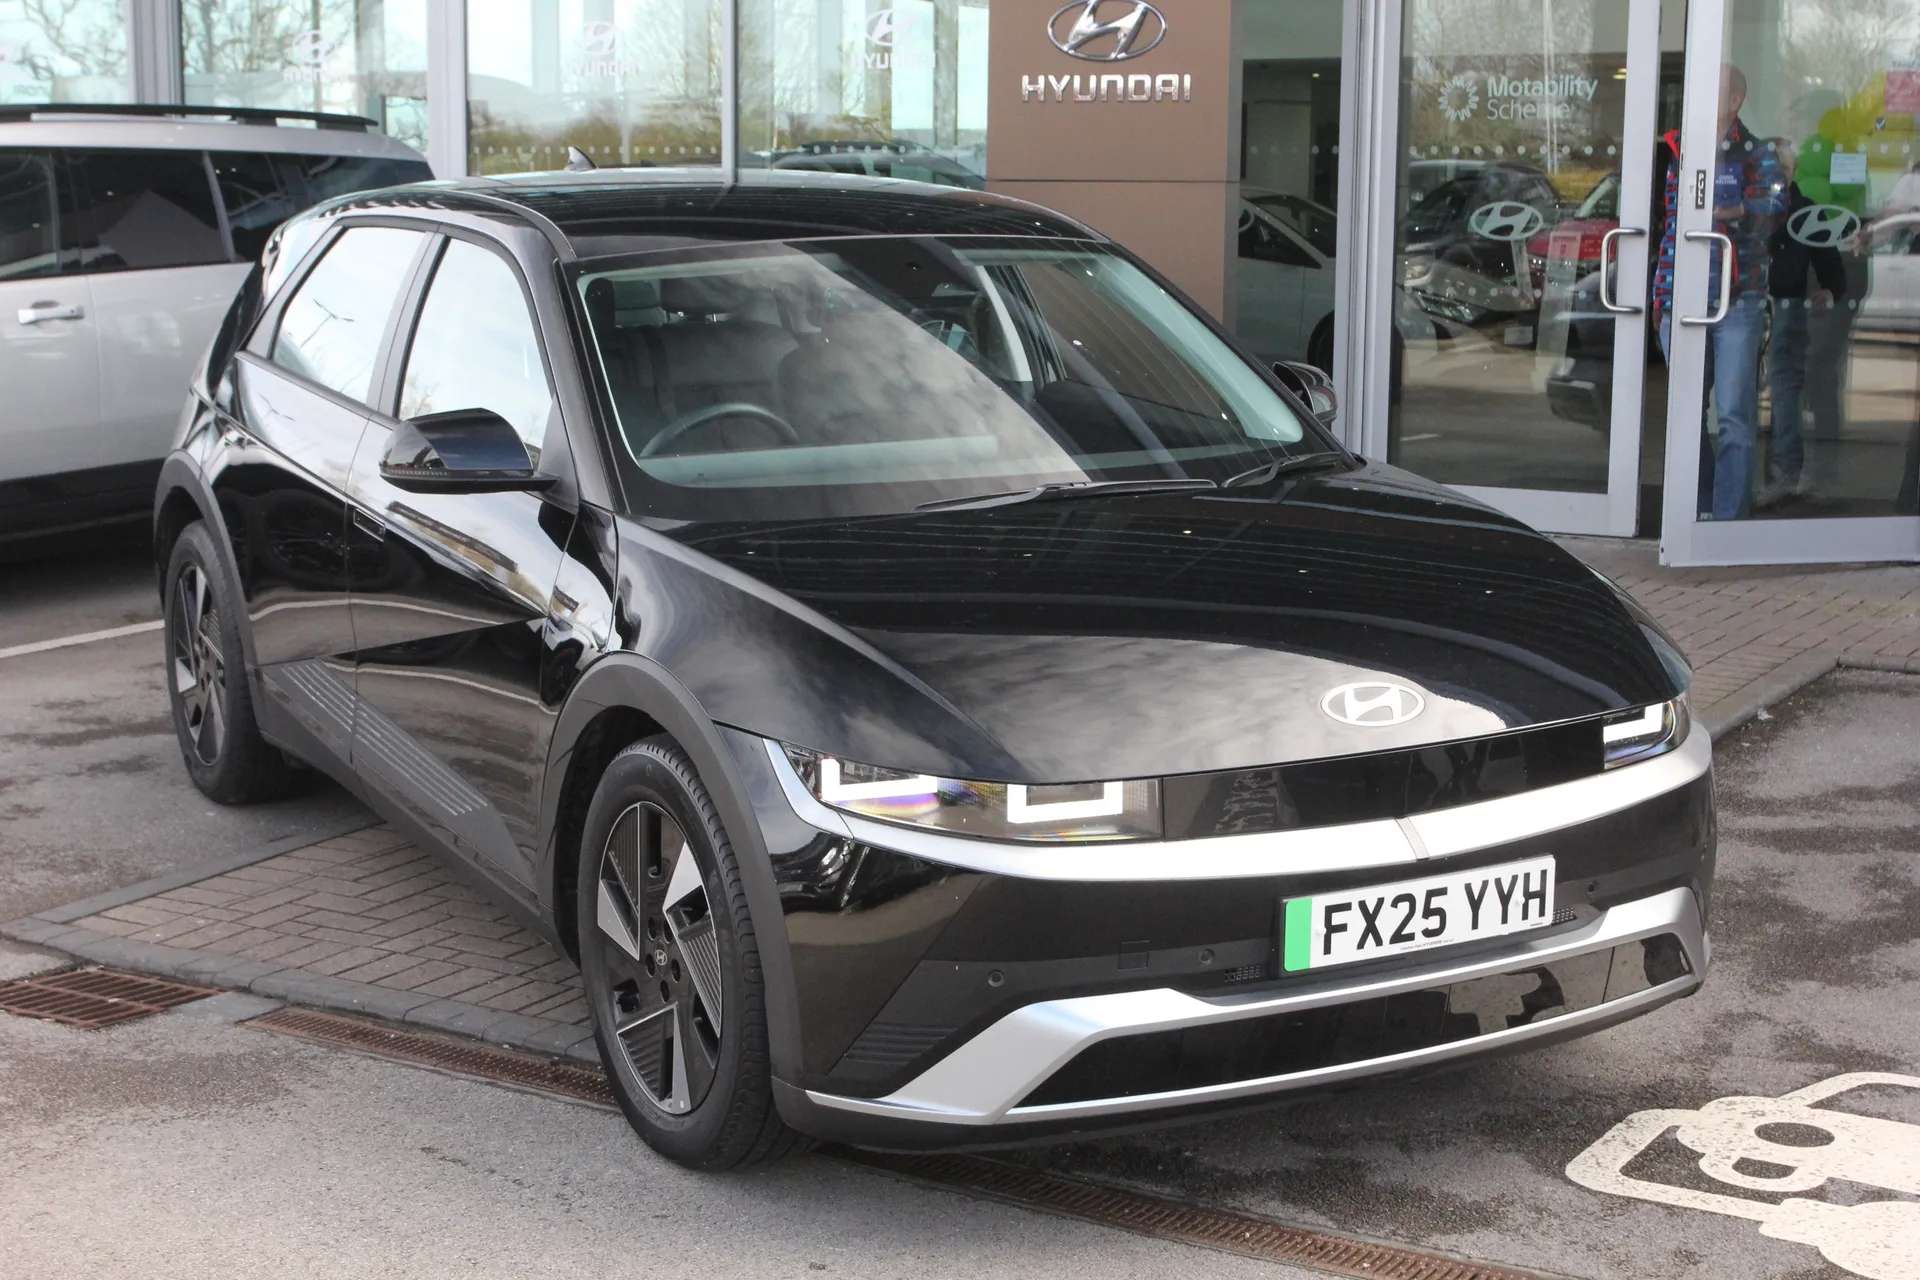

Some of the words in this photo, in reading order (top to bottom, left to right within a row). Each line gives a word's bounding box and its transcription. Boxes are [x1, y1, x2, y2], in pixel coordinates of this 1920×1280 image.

[1021, 74, 1192, 102] HYUNDAI
[1487, 74, 1598, 101] Motability
[1487, 99, 1571, 121] Scheme
[1697, 173, 1705, 206] PULL
[1322, 886, 1449, 956] FX25
[1464, 868, 1548, 932] YYH
